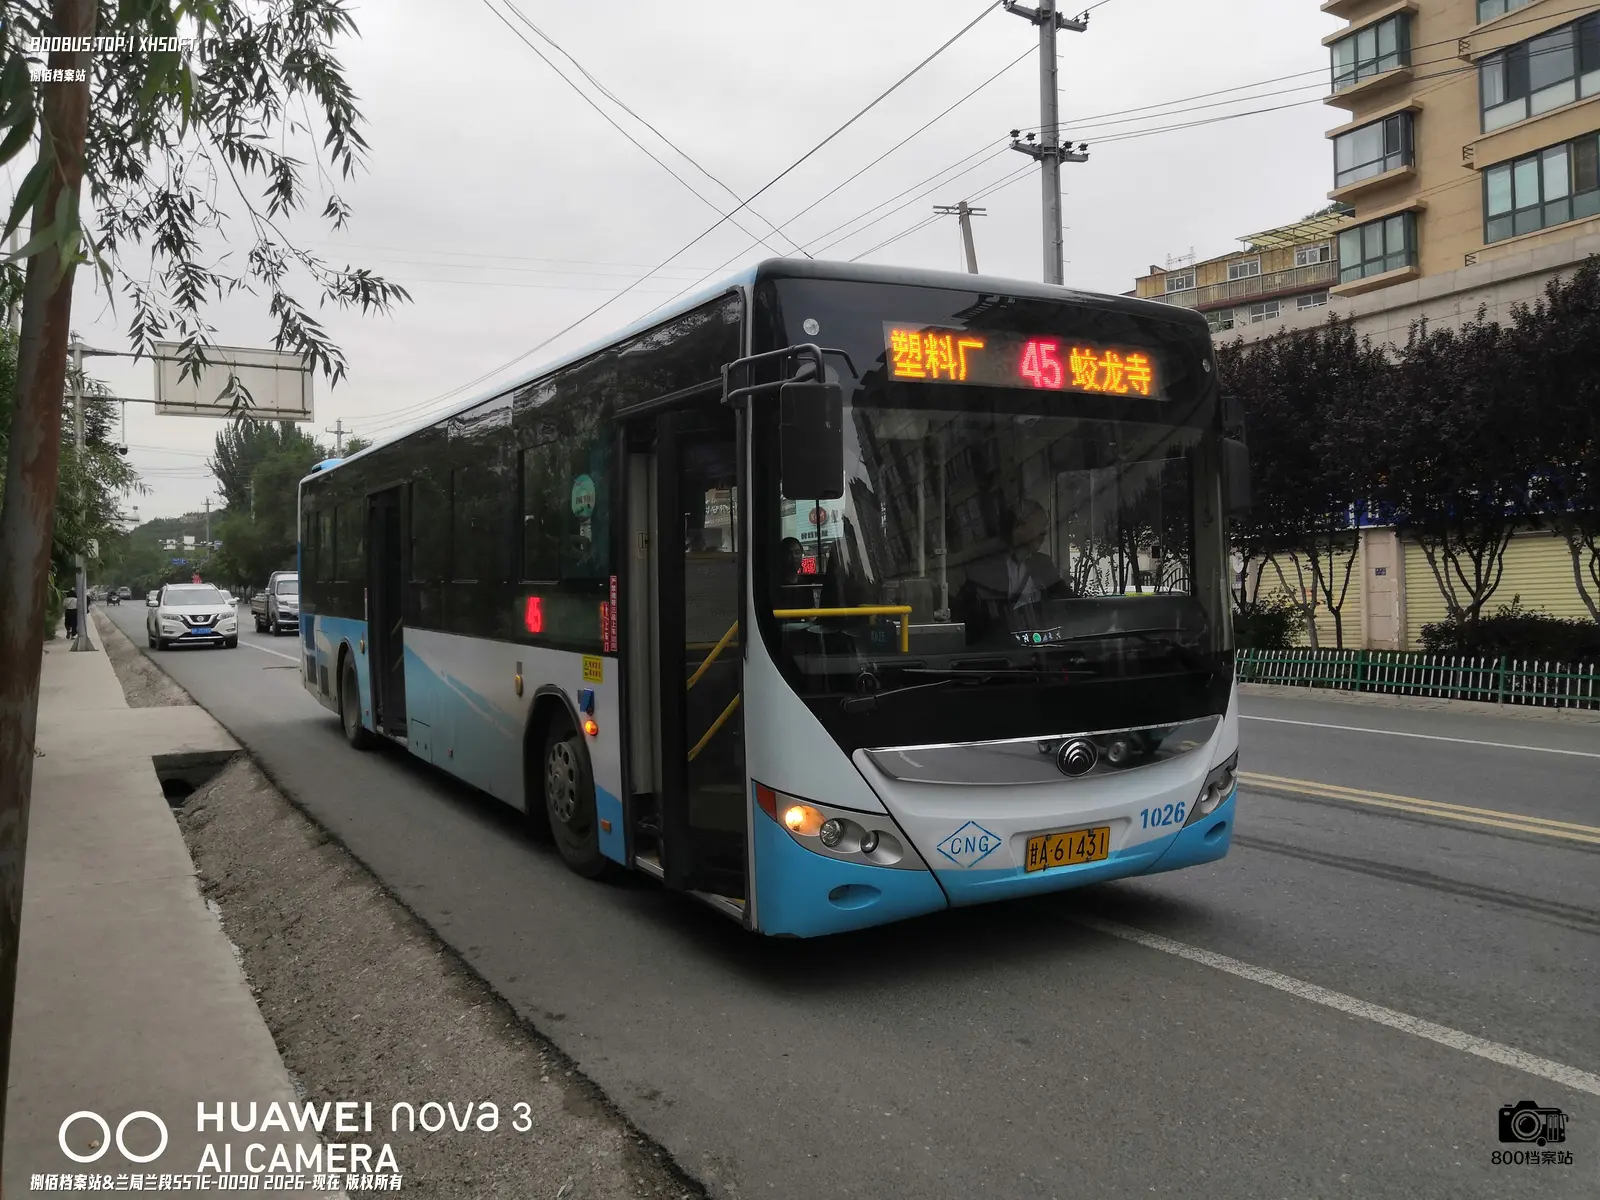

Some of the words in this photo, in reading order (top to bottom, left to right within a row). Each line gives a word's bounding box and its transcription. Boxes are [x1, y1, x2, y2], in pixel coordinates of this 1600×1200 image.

[891, 329, 984, 381] 塑料厂
[1019, 340, 1062, 388] 45
[1070, 347, 1151, 395] 蛟龙寺
[1140, 801, 1186, 829] 1026
[950, 836, 989, 855] CNG
